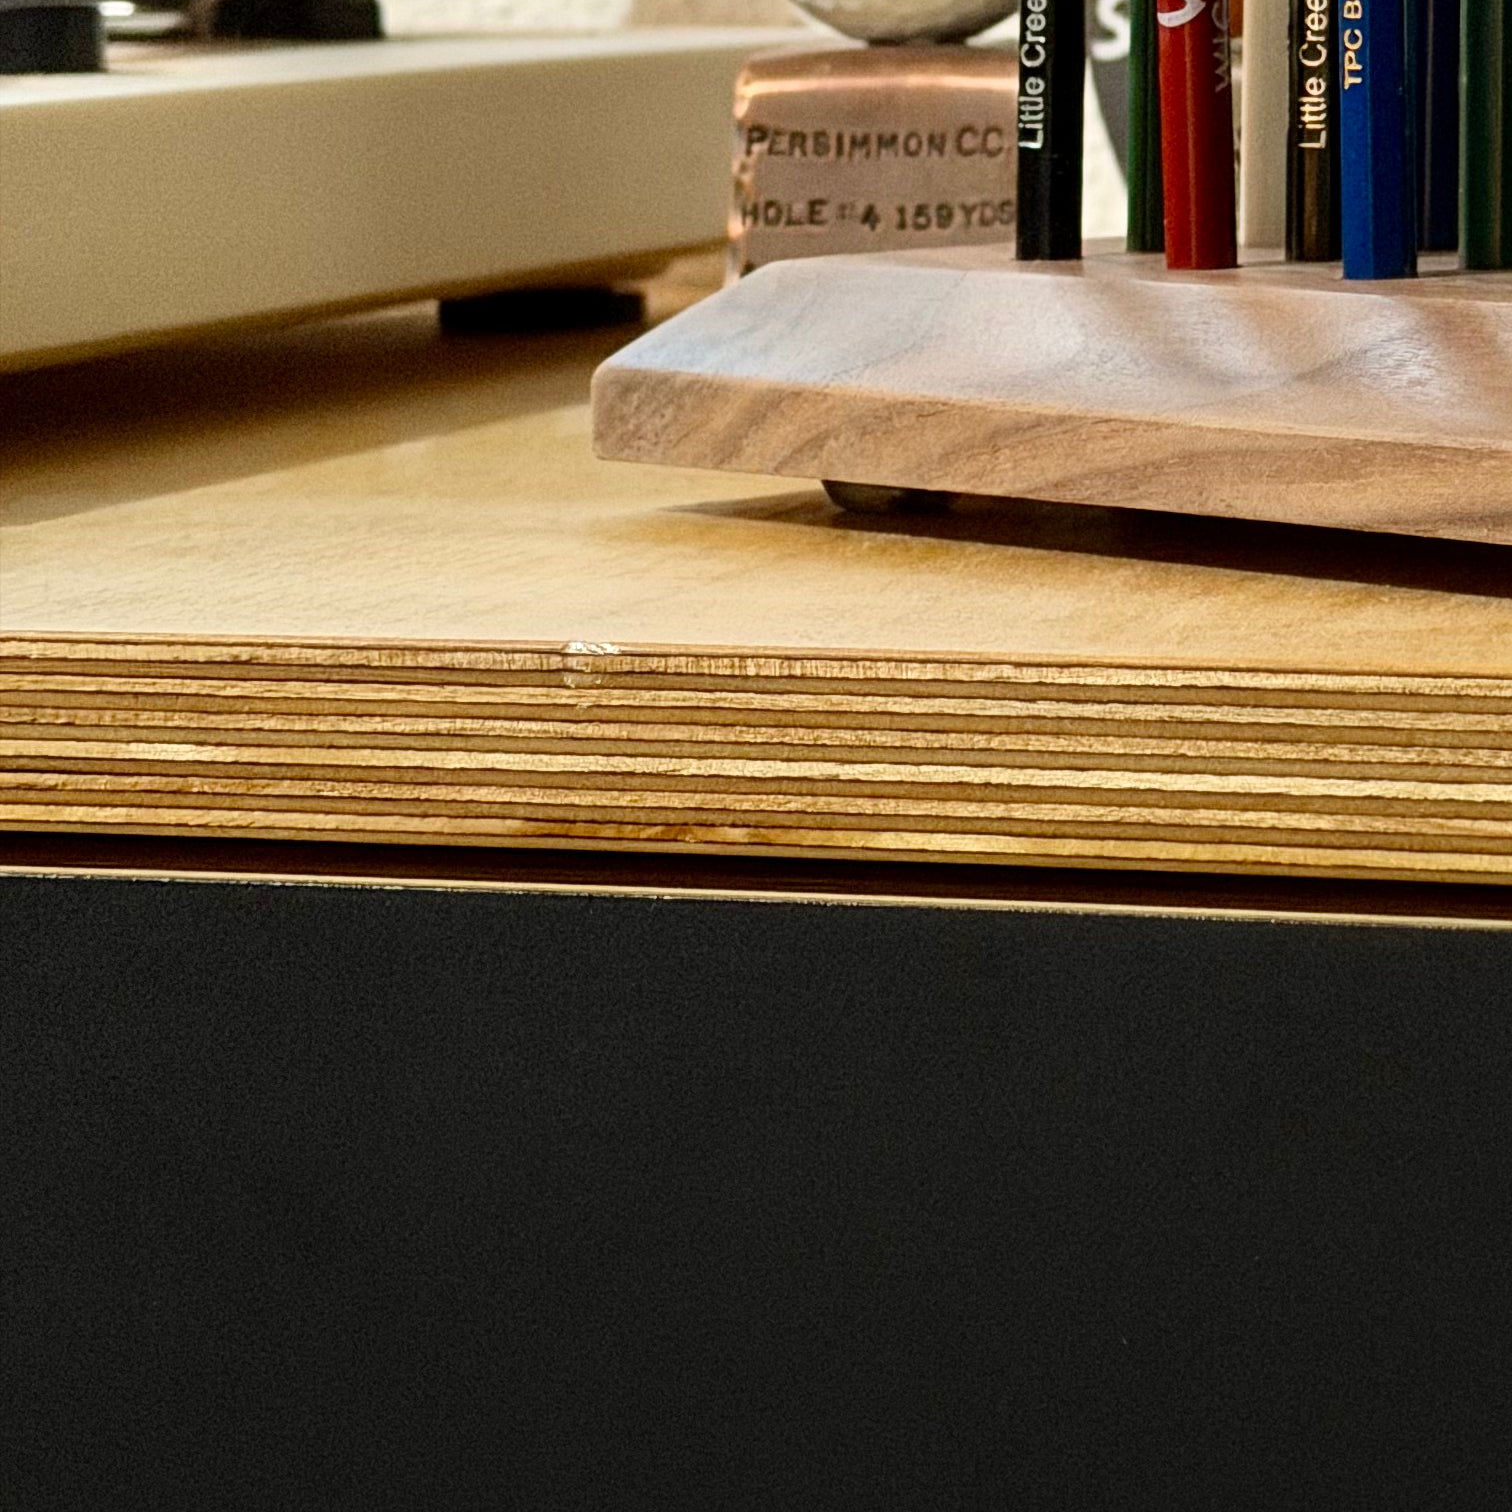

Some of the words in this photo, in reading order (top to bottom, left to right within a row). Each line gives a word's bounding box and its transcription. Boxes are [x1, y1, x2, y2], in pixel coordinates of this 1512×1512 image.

[1343, 28, 1364, 91] TPC
[1018, 76, 1045, 149] Little
[1298, 75, 1327, 149] Little
[740, 198, 829, 227] HOLE
